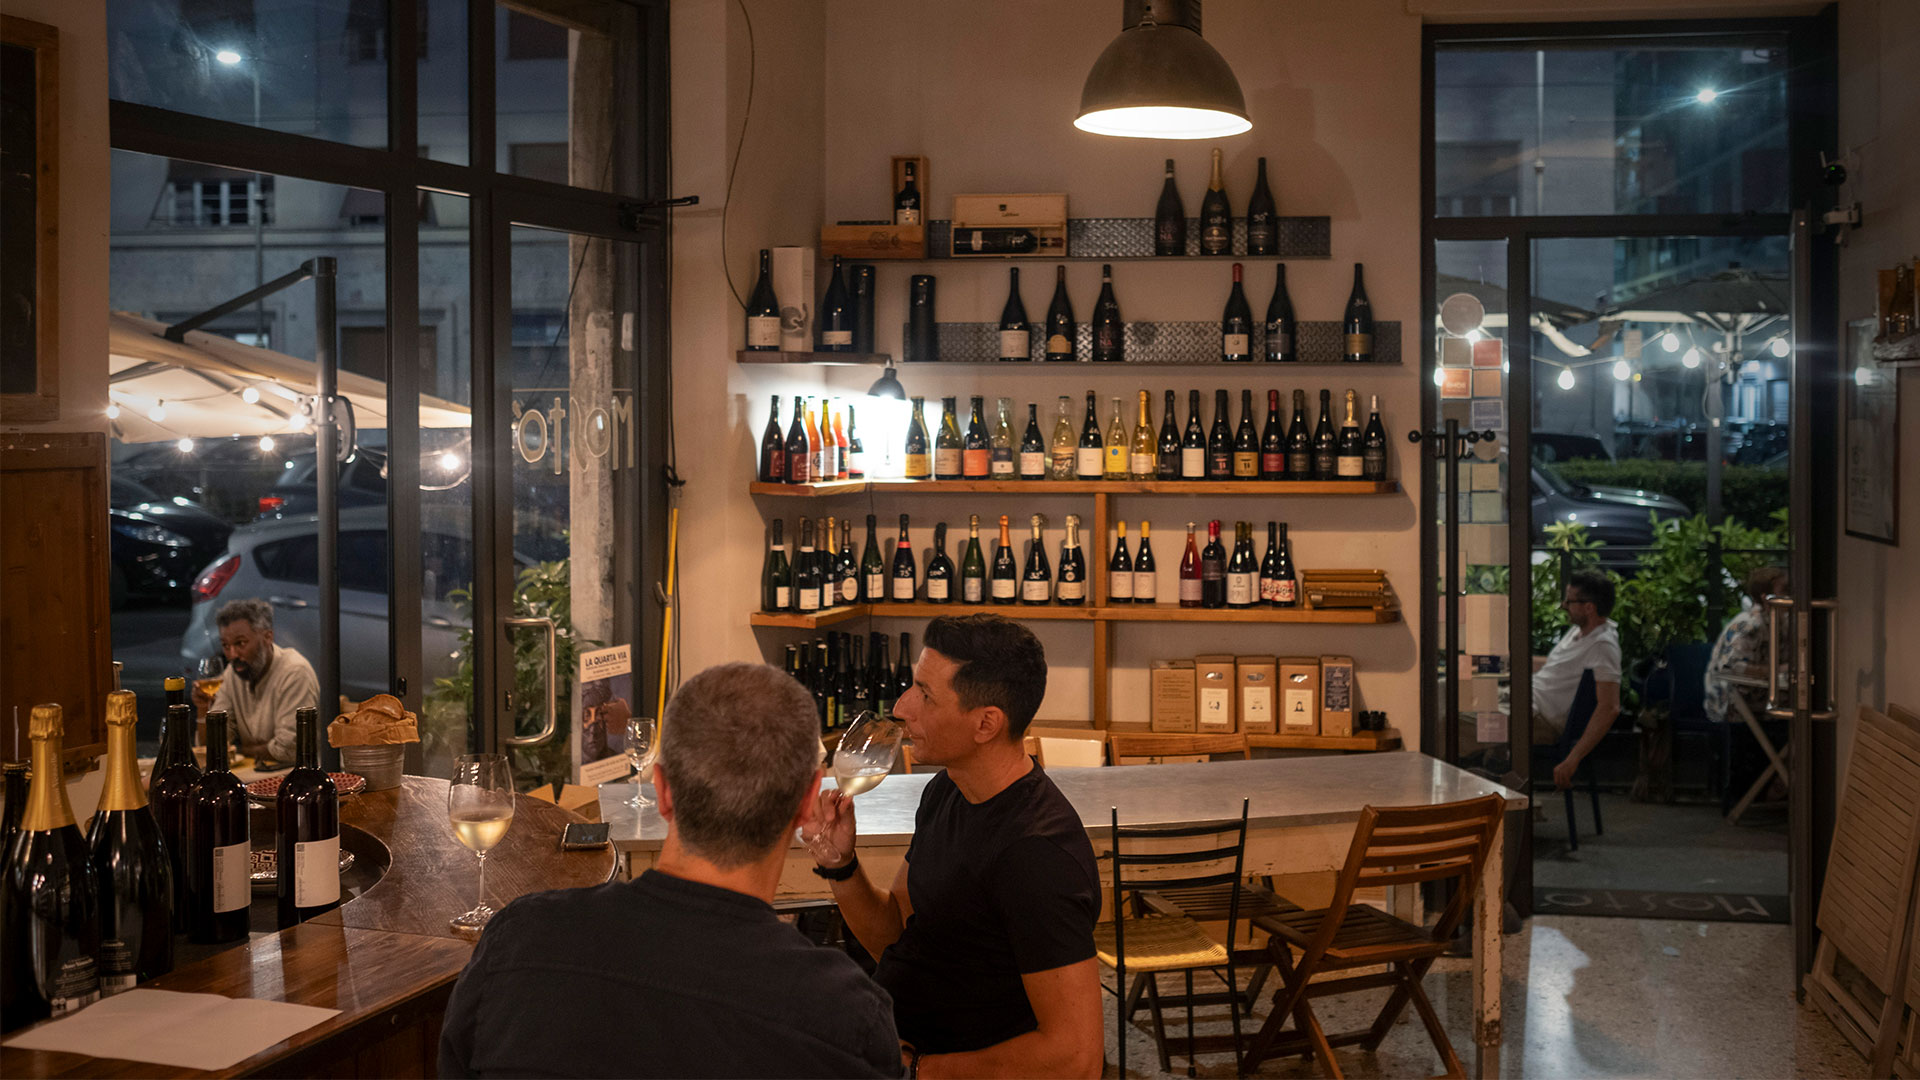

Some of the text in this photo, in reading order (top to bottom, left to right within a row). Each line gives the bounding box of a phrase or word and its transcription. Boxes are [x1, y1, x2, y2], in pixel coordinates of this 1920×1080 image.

[585, 657, 593, 667] LA
[594, 653, 617, 665] QUARTA
[617, 651, 627, 660] VIA
